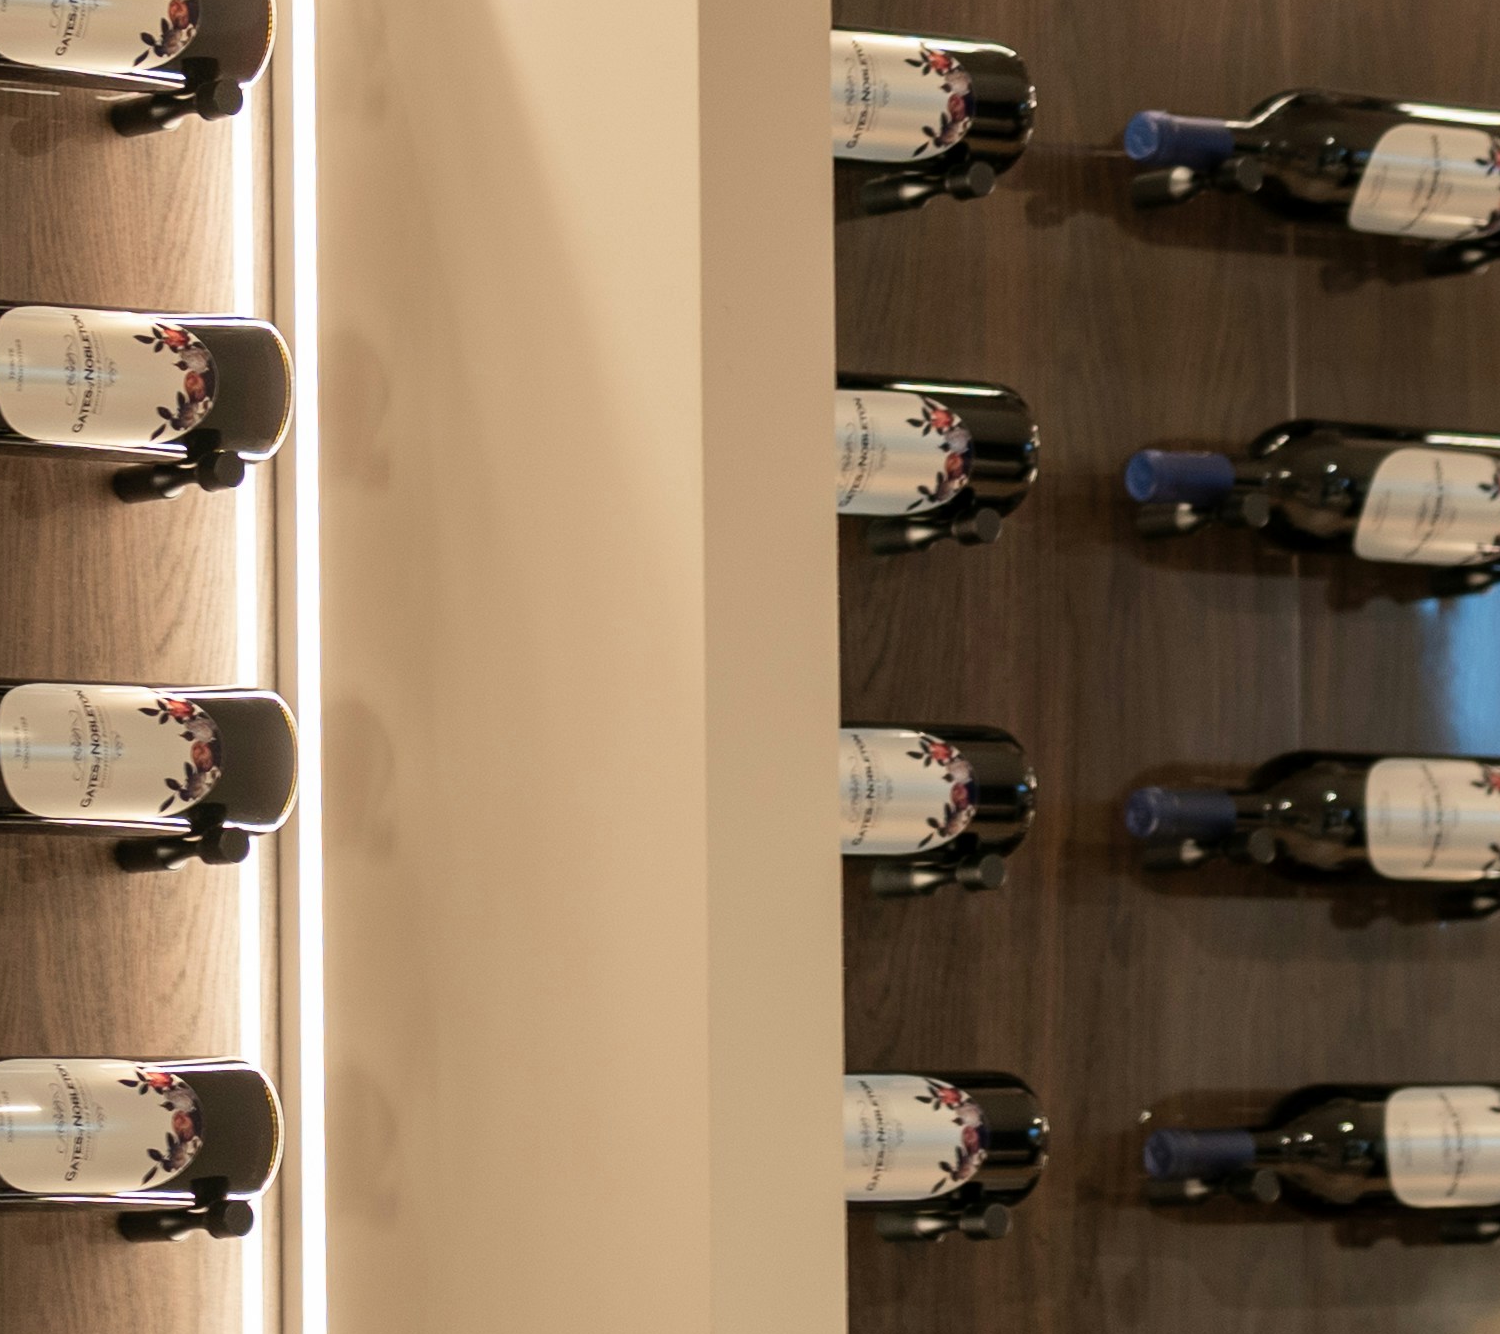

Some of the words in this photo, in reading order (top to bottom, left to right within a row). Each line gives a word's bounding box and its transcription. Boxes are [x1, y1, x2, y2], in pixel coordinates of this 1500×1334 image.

[54, 13, 76, 56] GATES
[72, 314, 94, 380] NOBLETON
[72, 390, 93, 432] GATES
[74, 690, 100, 755] NOBLETON
[80, 764, 99, 807] GATES
[54, 1064, 83, 1126] NOBLETON
[65, 1136, 83, 1181] GATES
